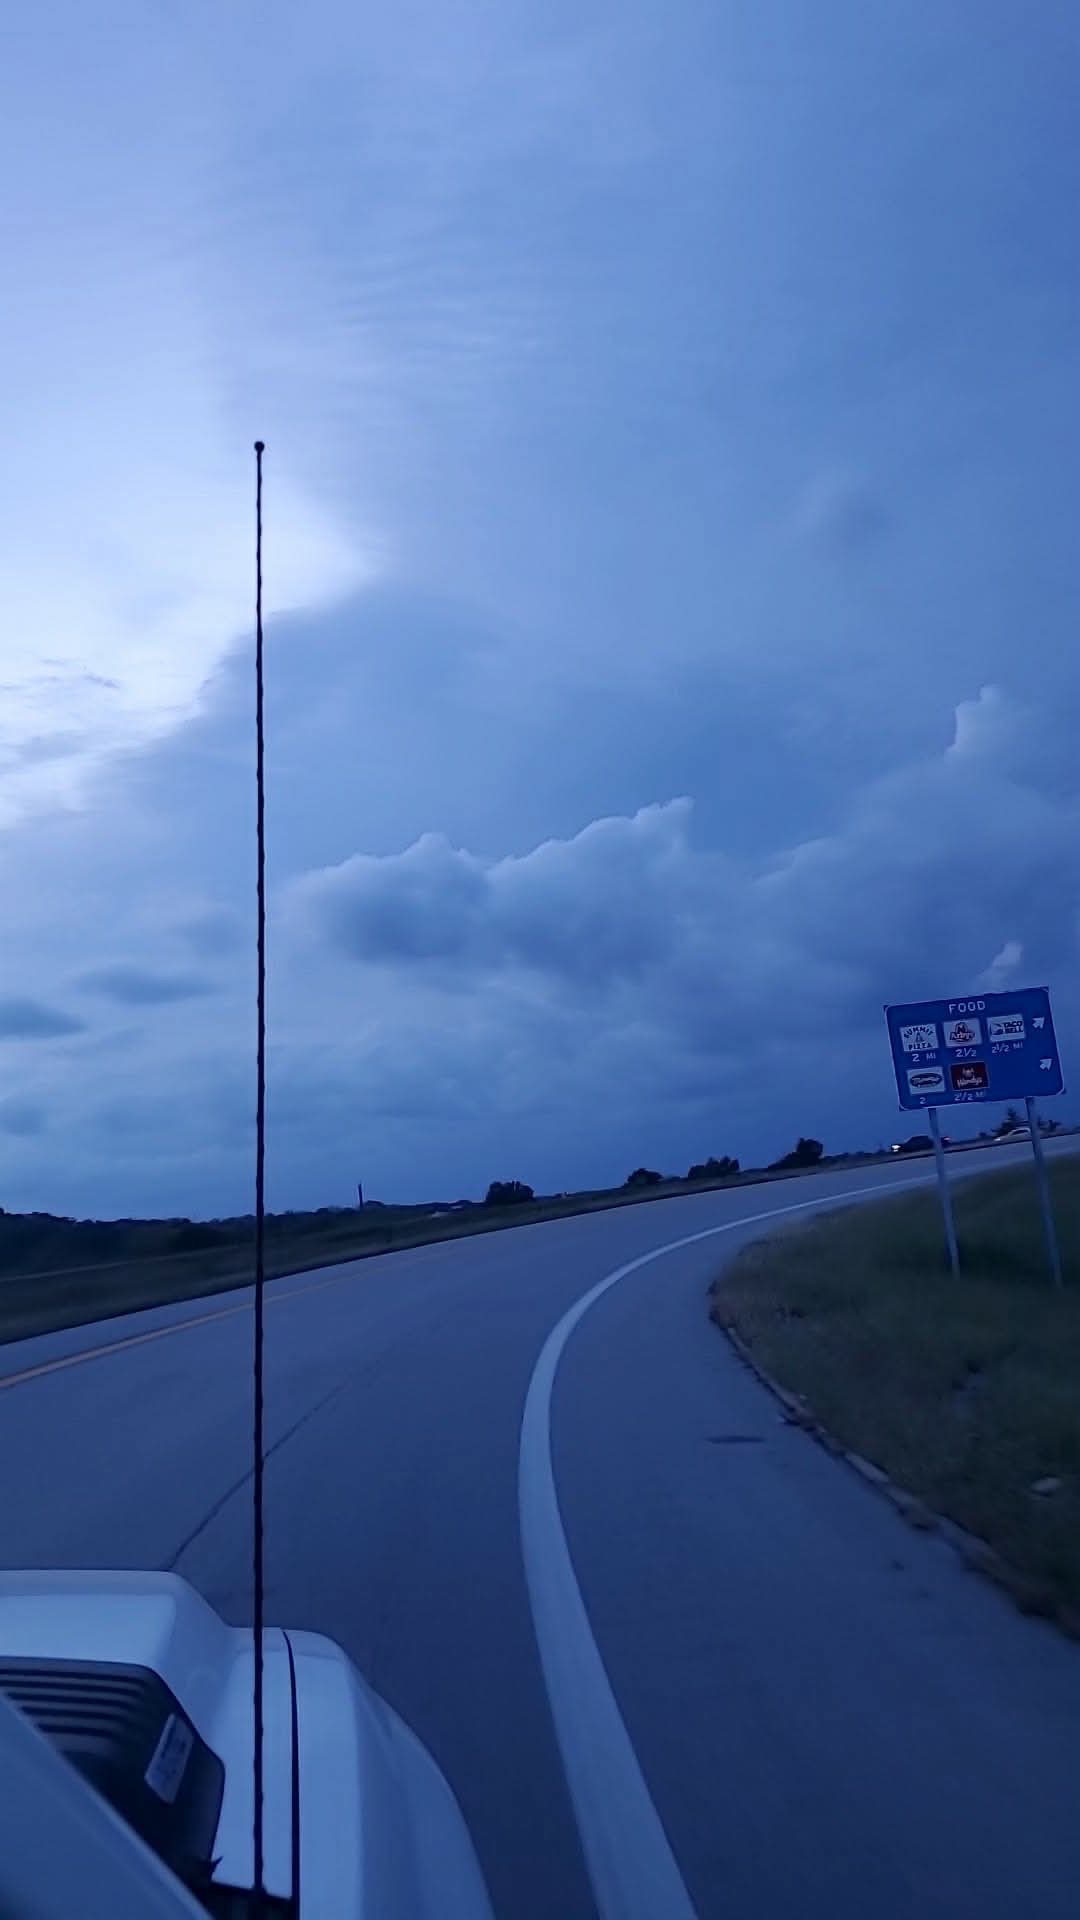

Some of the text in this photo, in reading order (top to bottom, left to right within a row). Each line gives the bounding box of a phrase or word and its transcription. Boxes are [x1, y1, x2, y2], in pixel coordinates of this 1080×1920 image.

[948, 1000, 986, 1015] FOOD
[903, 1025, 934, 1039] SUMMIT
[908, 1042, 932, 1050] PIZZA
[911, 1053, 921, 1062] 2
[919, 1096, 927, 1105] 2
